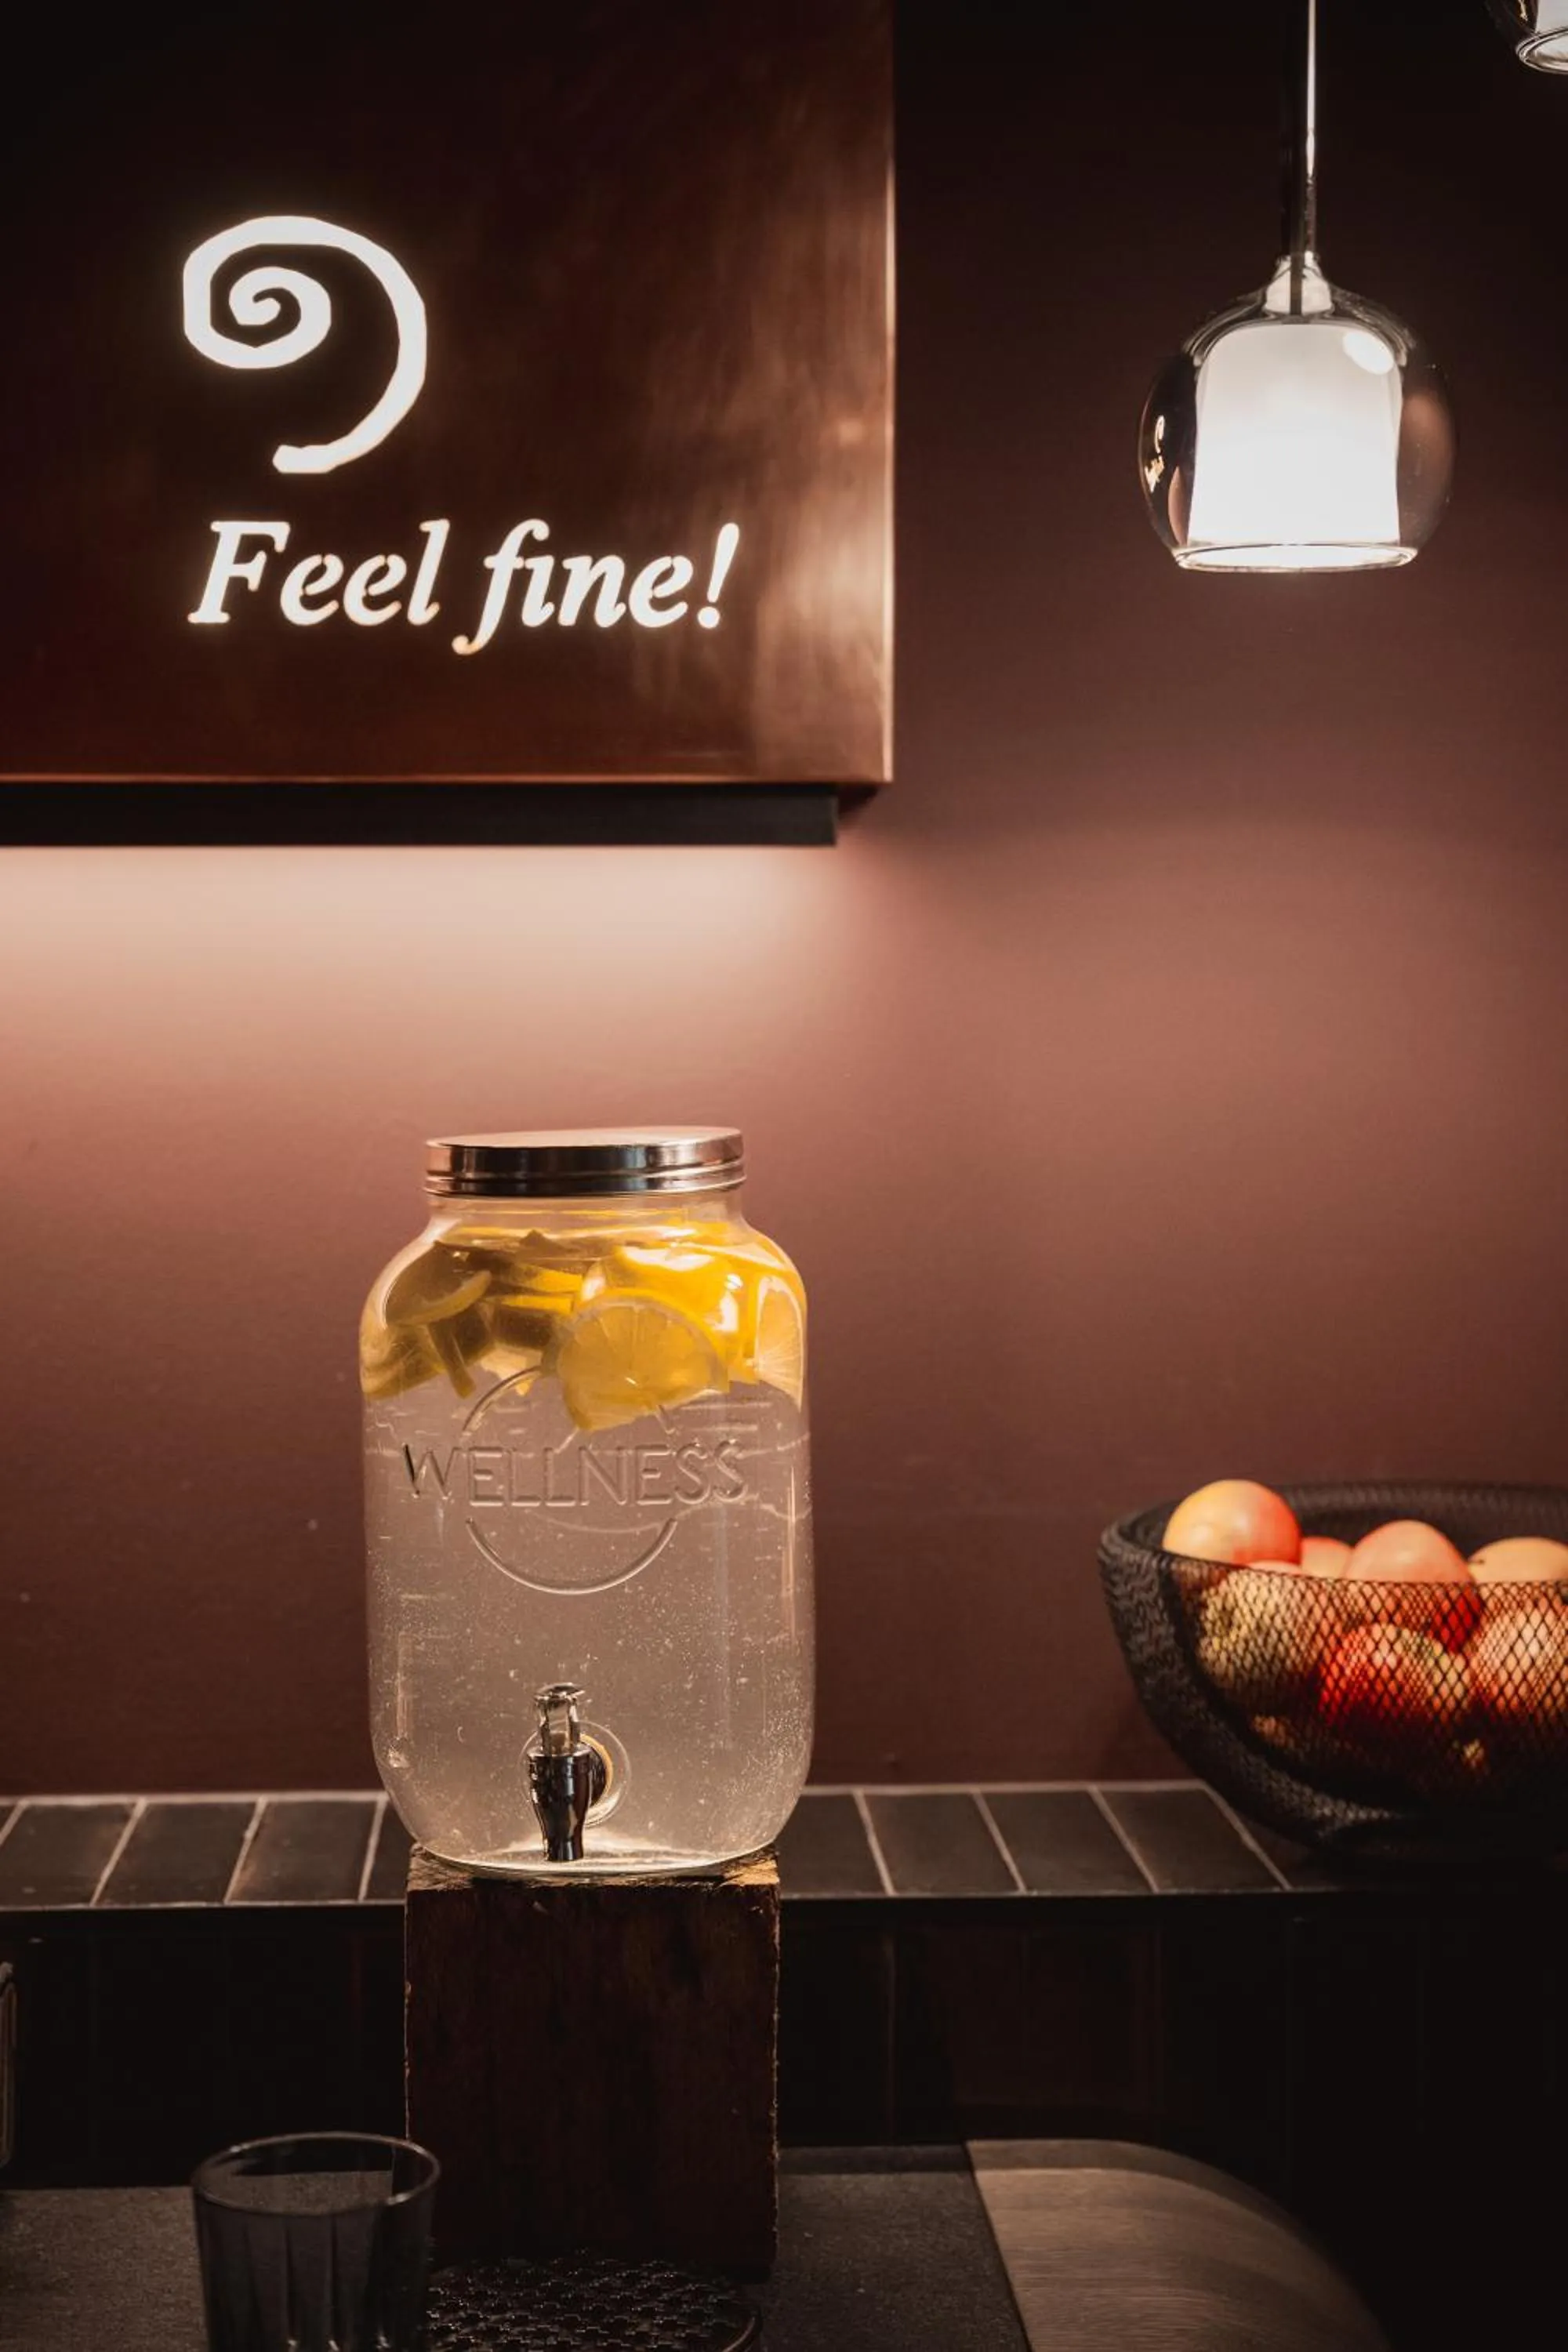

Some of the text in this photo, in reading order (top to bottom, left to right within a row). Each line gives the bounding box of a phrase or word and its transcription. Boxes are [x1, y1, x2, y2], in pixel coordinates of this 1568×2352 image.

[187, 519, 740, 655] Feel fine!
[402, 1439, 749, 1507] WELLNESS
